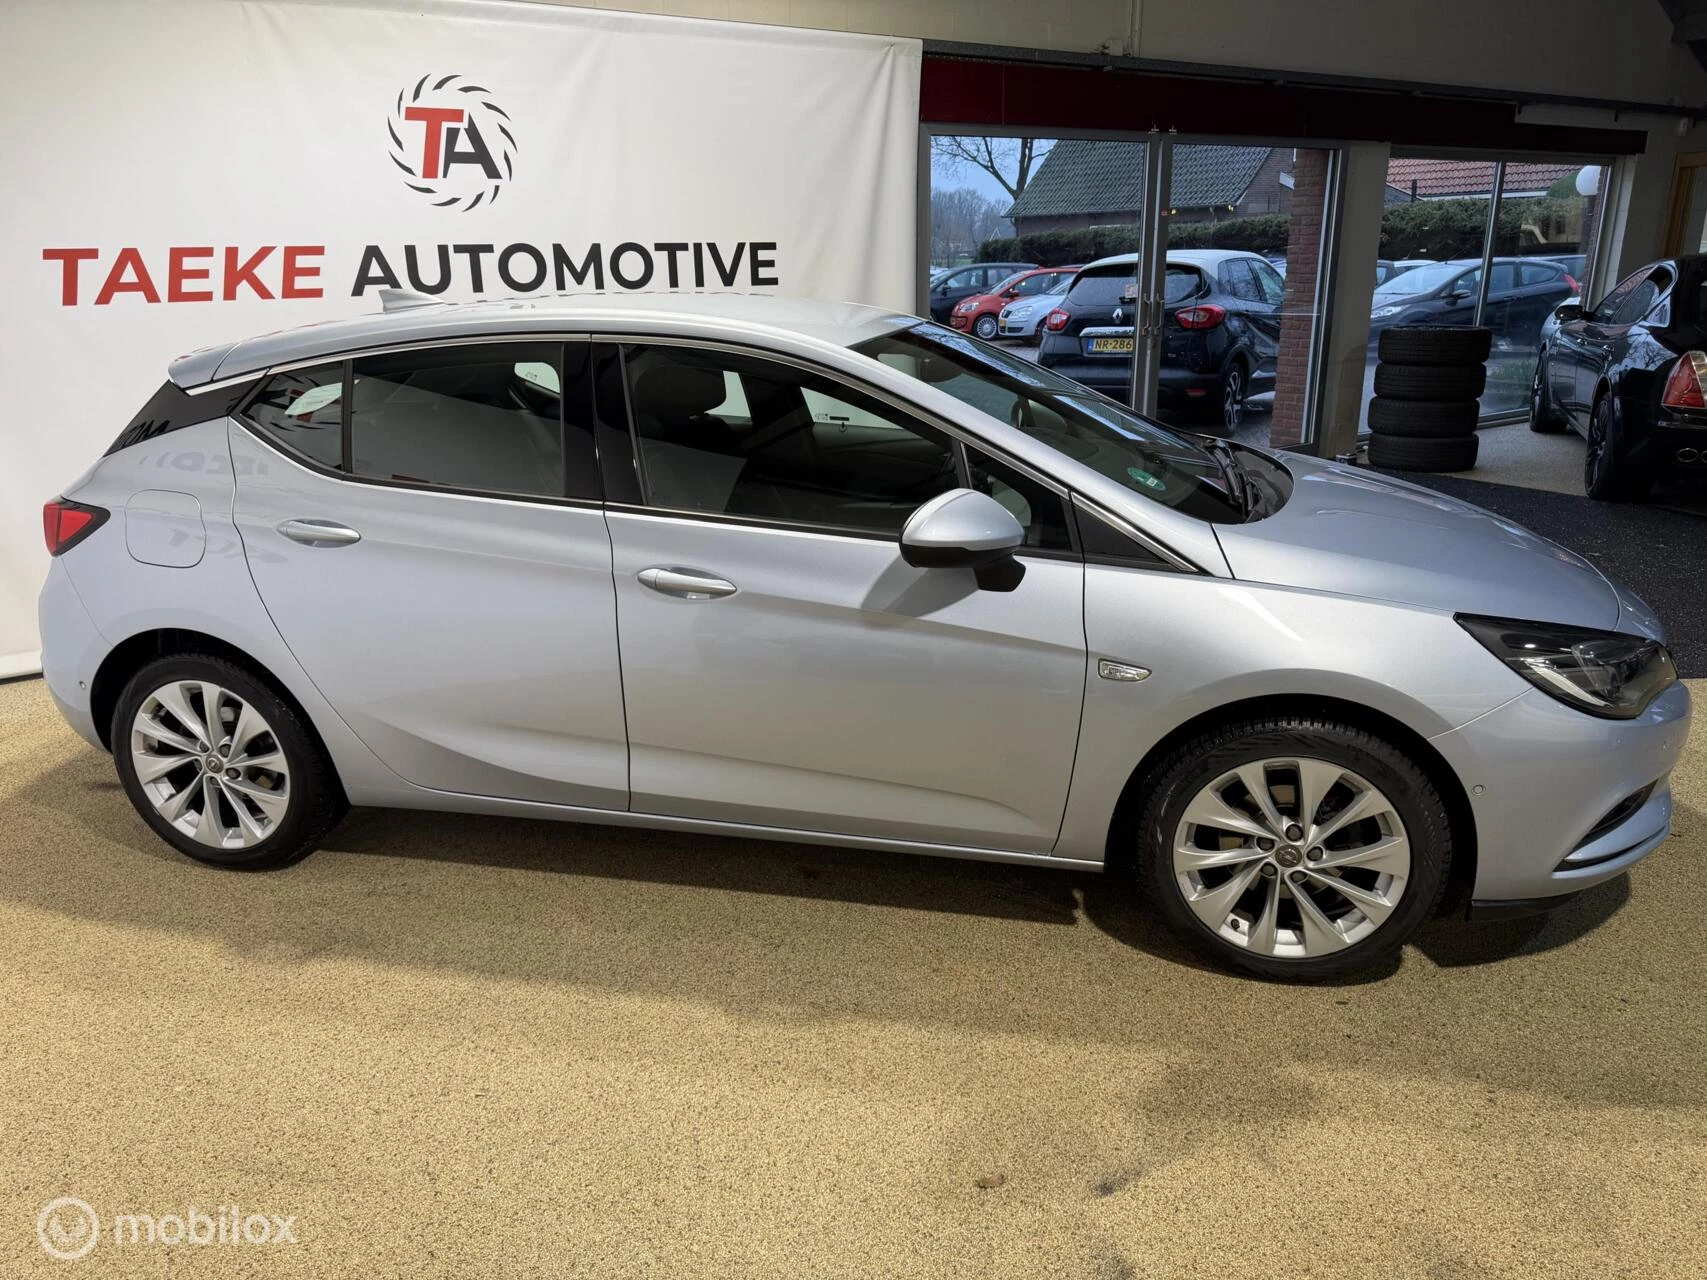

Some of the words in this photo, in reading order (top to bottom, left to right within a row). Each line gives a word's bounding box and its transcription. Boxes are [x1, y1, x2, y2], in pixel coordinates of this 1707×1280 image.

[405, 107, 502, 180] TA
[43, 246, 325, 305] TAEKE
[351, 242, 779, 296] AUTOMOTIVE
